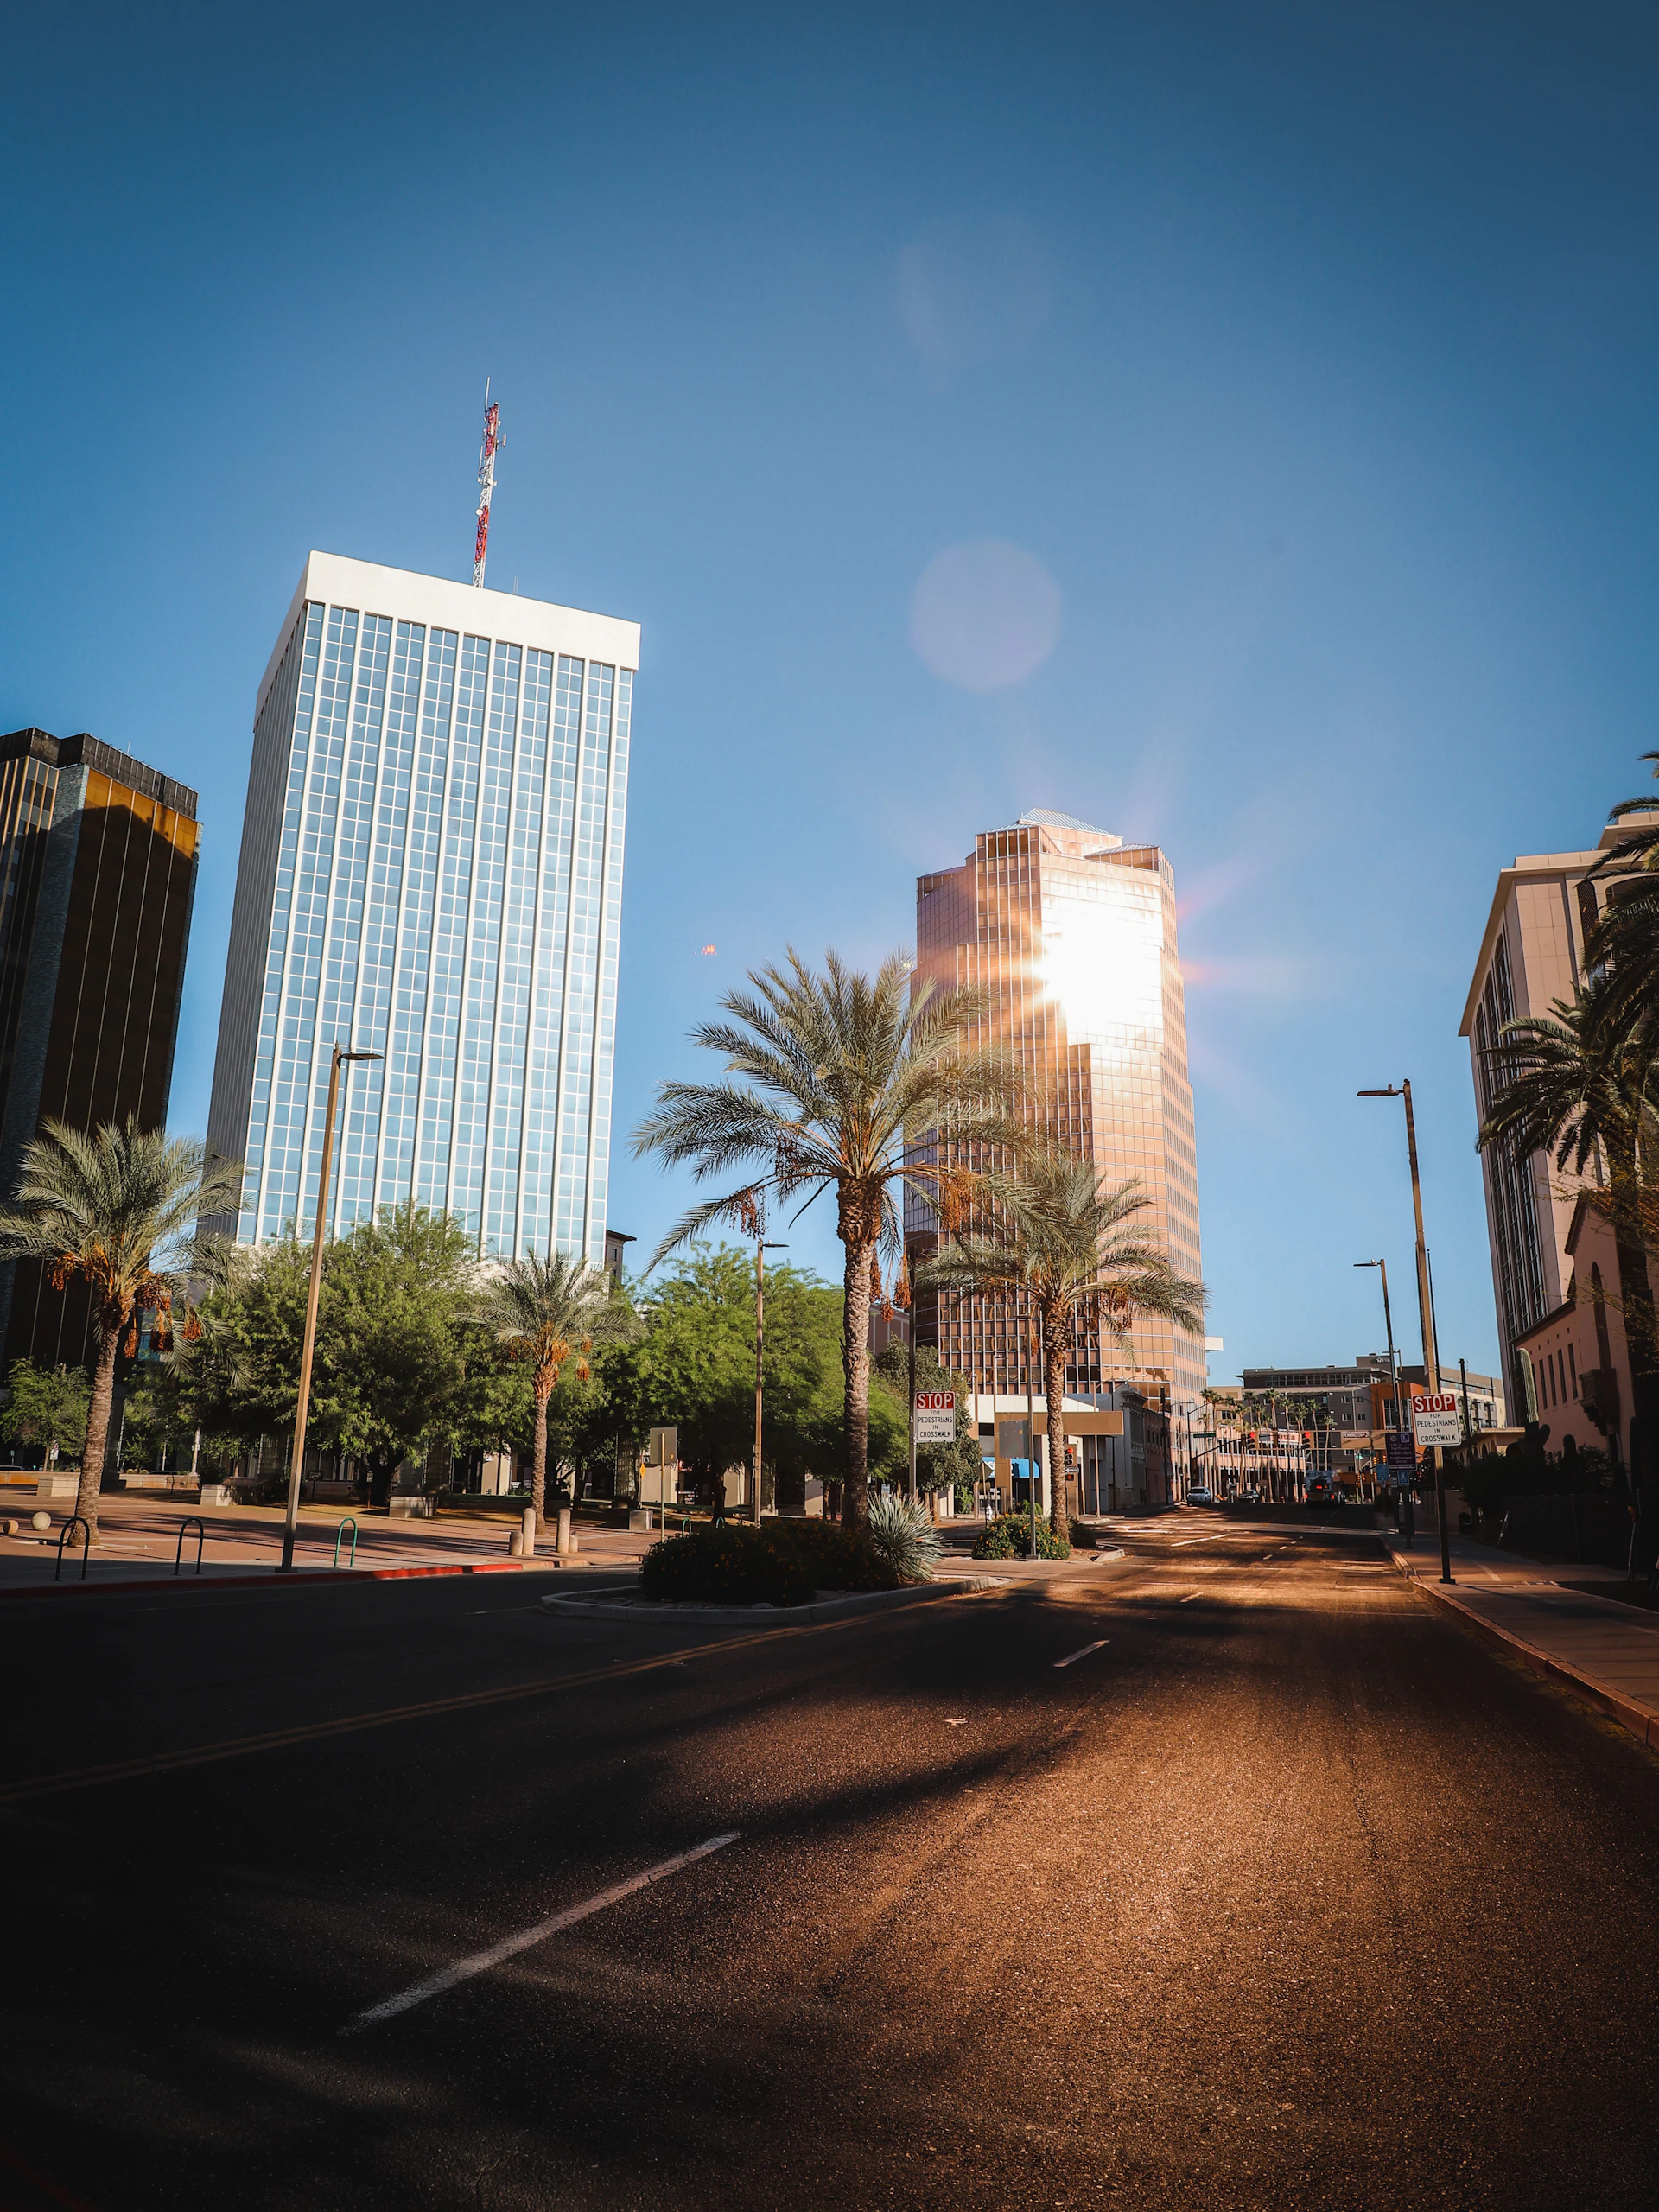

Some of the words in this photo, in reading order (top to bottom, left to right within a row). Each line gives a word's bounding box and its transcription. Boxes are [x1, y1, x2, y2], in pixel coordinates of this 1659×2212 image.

[918, 1393, 952, 1408] STOP
[1414, 1395, 1452, 1412] STOP
[1417, 1419, 1456, 1427] PEDESTRIANS
